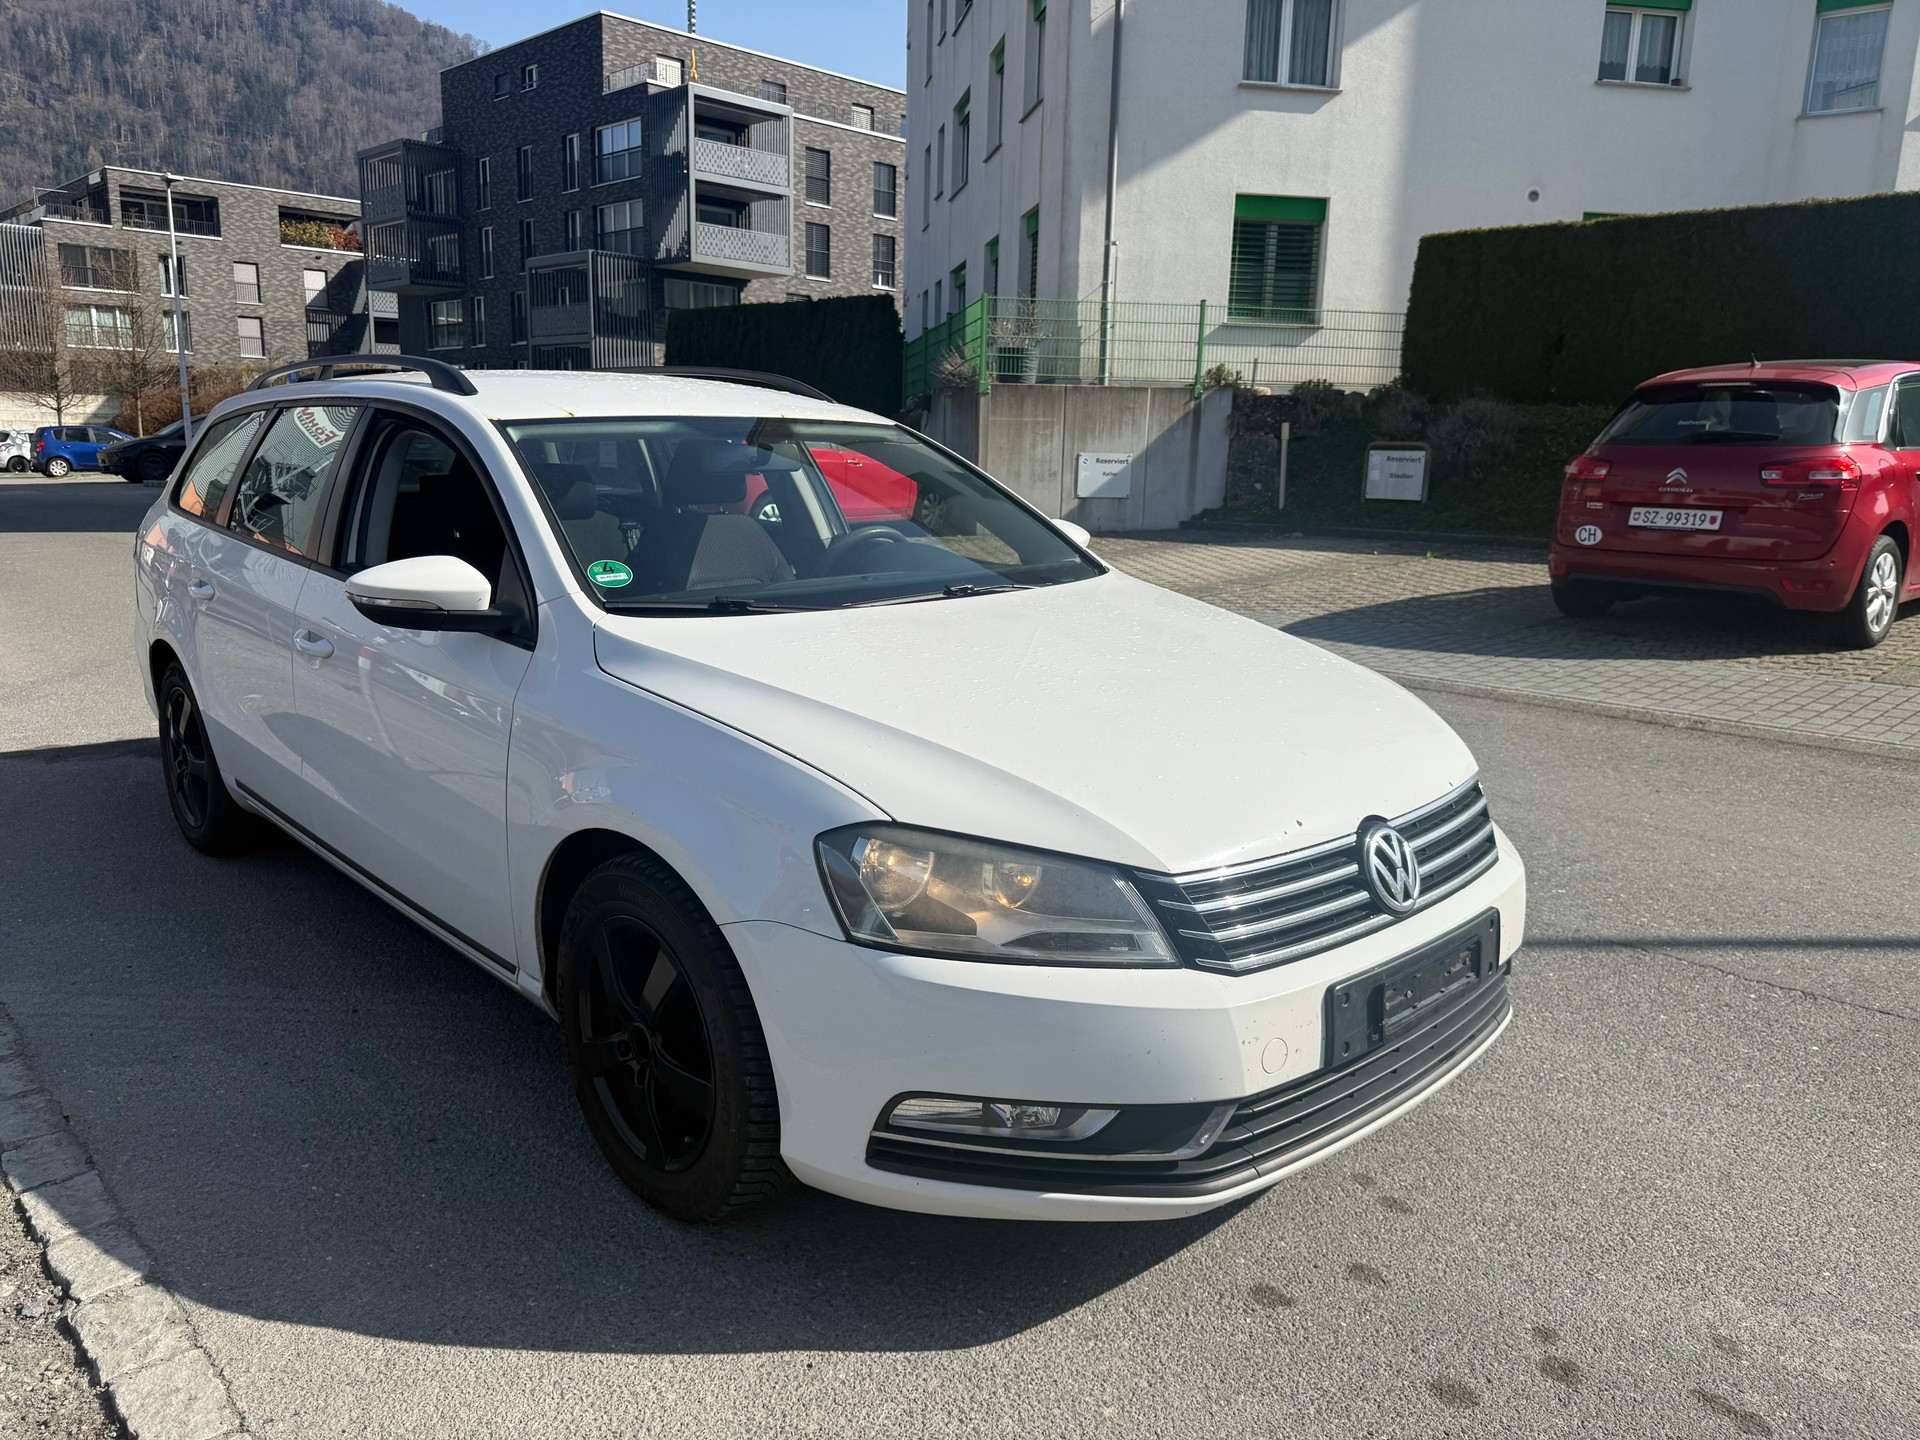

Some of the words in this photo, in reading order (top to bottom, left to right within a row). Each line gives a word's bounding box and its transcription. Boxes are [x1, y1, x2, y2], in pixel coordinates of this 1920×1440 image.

[1095, 457, 1129, 465] Reserviert
[1386, 455, 1422, 464] Reserviert
[1578, 527, 1597, 542] CH
[603, 561, 615, 574] 4
